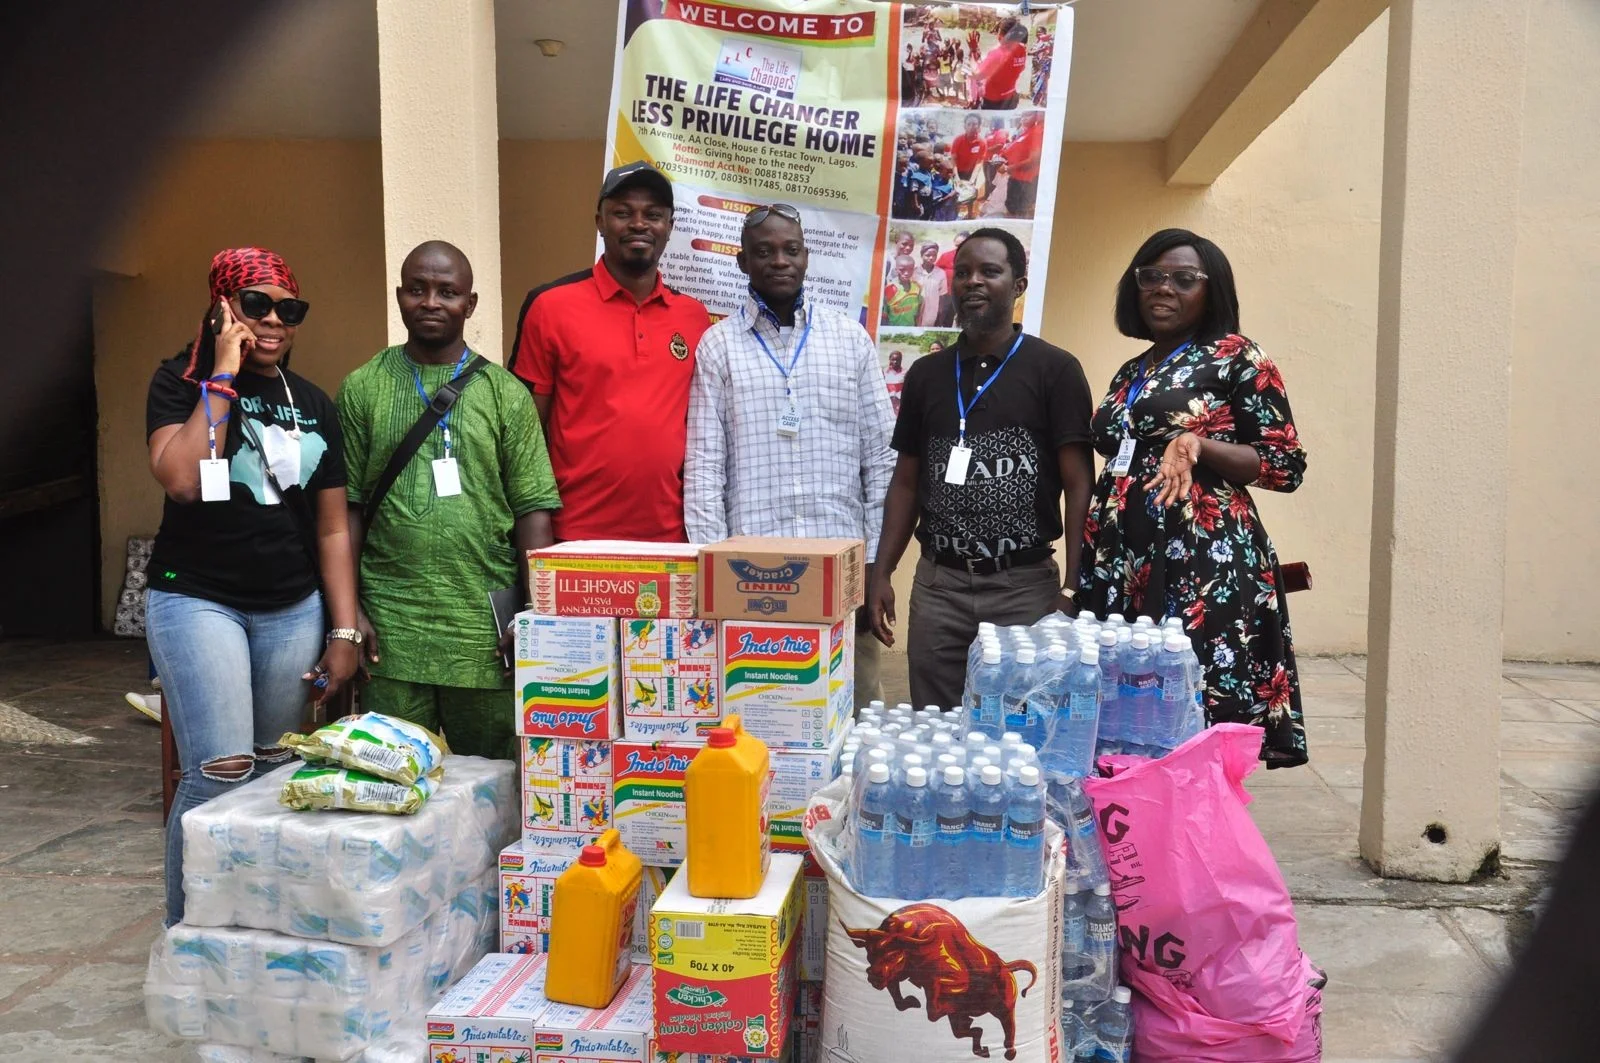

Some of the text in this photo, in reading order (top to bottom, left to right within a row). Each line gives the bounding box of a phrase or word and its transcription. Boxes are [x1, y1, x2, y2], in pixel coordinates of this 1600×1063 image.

[680, 3, 863, 35] WELCOME TO
[762, 57, 789, 75] The Life
[645, 74, 688, 102] THE
[693, 82, 743, 110] LIFE
[749, 94, 860, 131] CHANGER
[631, 100, 877, 158] LESS PRIVILEGE HOME
[650, 127, 686, 143] Avenue,
[688, 135, 702, 145] AA
[703, 136, 729, 149] Close,
[731, 142, 758, 154] House
[761, 146, 767, 155] 6
[769, 147, 797, 160] Festac
[800, 151, 826, 165] Town,
[829, 156, 858, 169] Lagos.
[672, 142, 816, 175] Motto: Giving hope to the needy
[674, 154, 811, 183] Diamond Acct No: 0088182853
[722, 200, 757, 213] VISIO
[697, 208, 717, 218] Home
[720, 214, 738, 222] want
[803, 228, 836, 238] potential
[698, 219, 721, 228] ensure
[722, 223, 737, 232] that
[804, 239, 841, 249] eintegrate
[842, 241, 859, 251] their
[701, 228, 725, 240] happy,
[711, 243, 742, 256] MISS
[669, 252, 690, 261] stable
[692, 254, 732, 267] foundation
[837, 279, 852, 287] and
[679, 265, 714, 276] orphaned,
[817, 287, 851, 298] destitute
[668, 273, 683, 281] have
[685, 274, 697, 282] lost
[698, 276, 716, 285] their
[826, 298, 849, 309] loving
[721, 289, 736, 299] that
[712, 299, 741, 310] healthy
[240, 396, 265, 413] OR
[934, 455, 1035, 481] PADA
[966, 478, 996, 487] MILANO
[742, 565, 793, 580] Cracker
[559, 578, 636, 594] SPAGHETTI
[744, 582, 792, 592] MINI
[583, 596, 612, 606] PASTA
[560, 605, 634, 616] GOLDEN PENNY
[744, 671, 799, 681] Instant Noodles
[541, 686, 590, 696] Instant Noodles
[616, 750, 694, 777] Indomi
[632, 788, 684, 799] Instant Noodles
[780, 824, 803, 832] nstant
[690, 960, 734, 972] 40 X 70g
[677, 992, 713, 1005] Chicken
[670, 1013, 701, 1024] Noodles
[659, 1019, 744, 1036] Golden Penny
